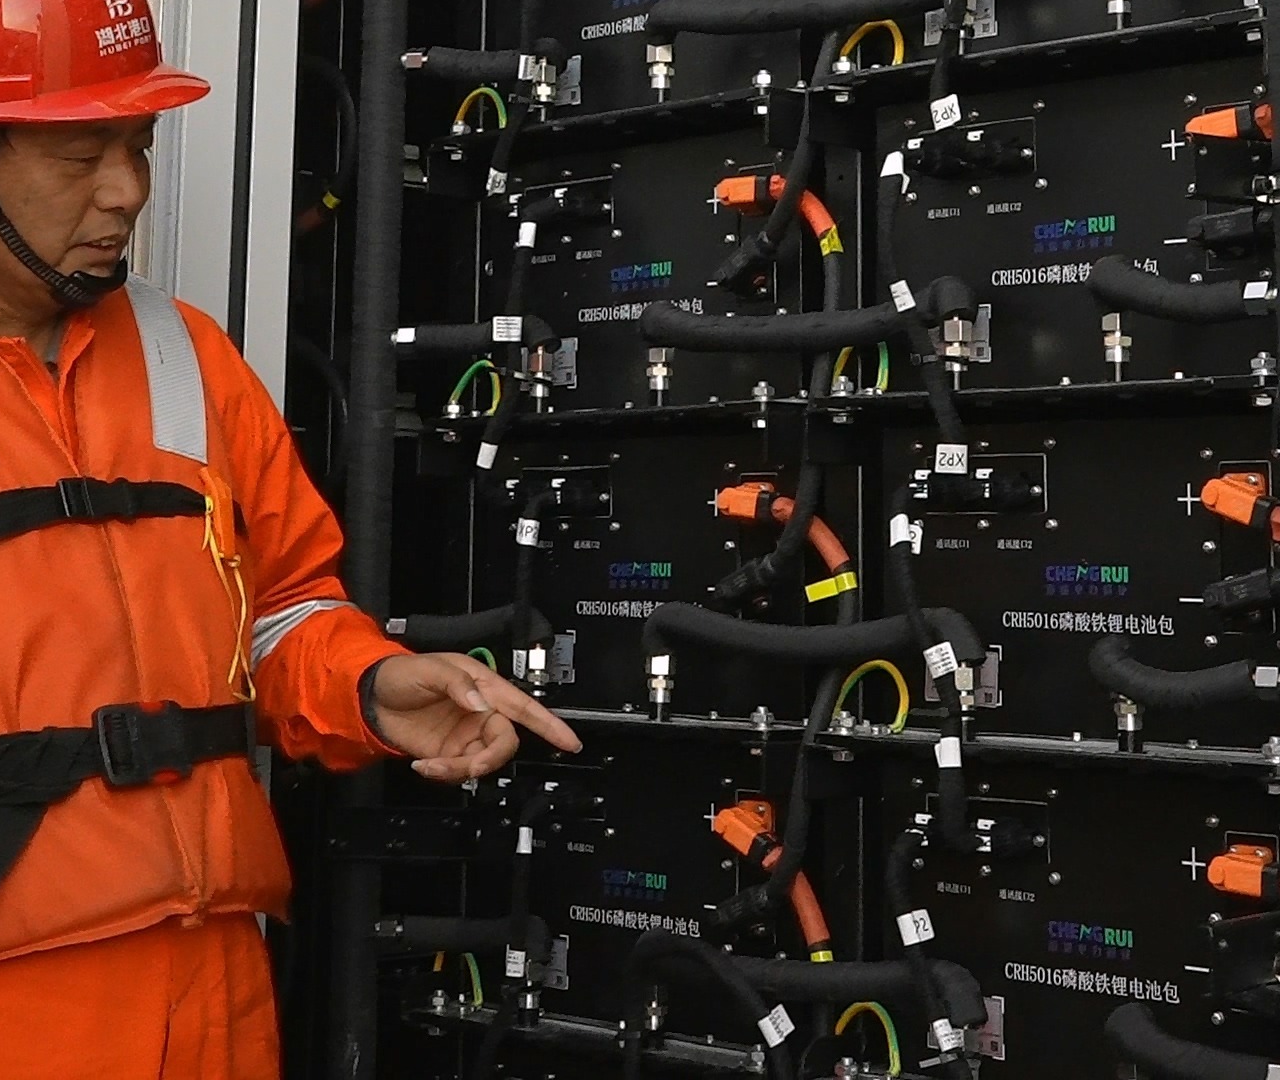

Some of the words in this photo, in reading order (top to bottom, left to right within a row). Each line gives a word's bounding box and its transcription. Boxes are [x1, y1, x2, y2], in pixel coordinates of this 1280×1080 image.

[94, 16, 151, 48] 湖北港口
[933, 104, 956, 124] XP2
[1034, 215, 1116, 240] CHENGRUI
[939, 451, 965, 468] XP2
[1046, 565, 1129, 582] CHENGRUI
[1003, 610, 1175, 636] CRH5016磷酸铁锂电池包
[1048, 922, 1133, 948] CHENGRUI
[1005, 962, 1180, 1005] CRH5016磷酸铁锂电池包
